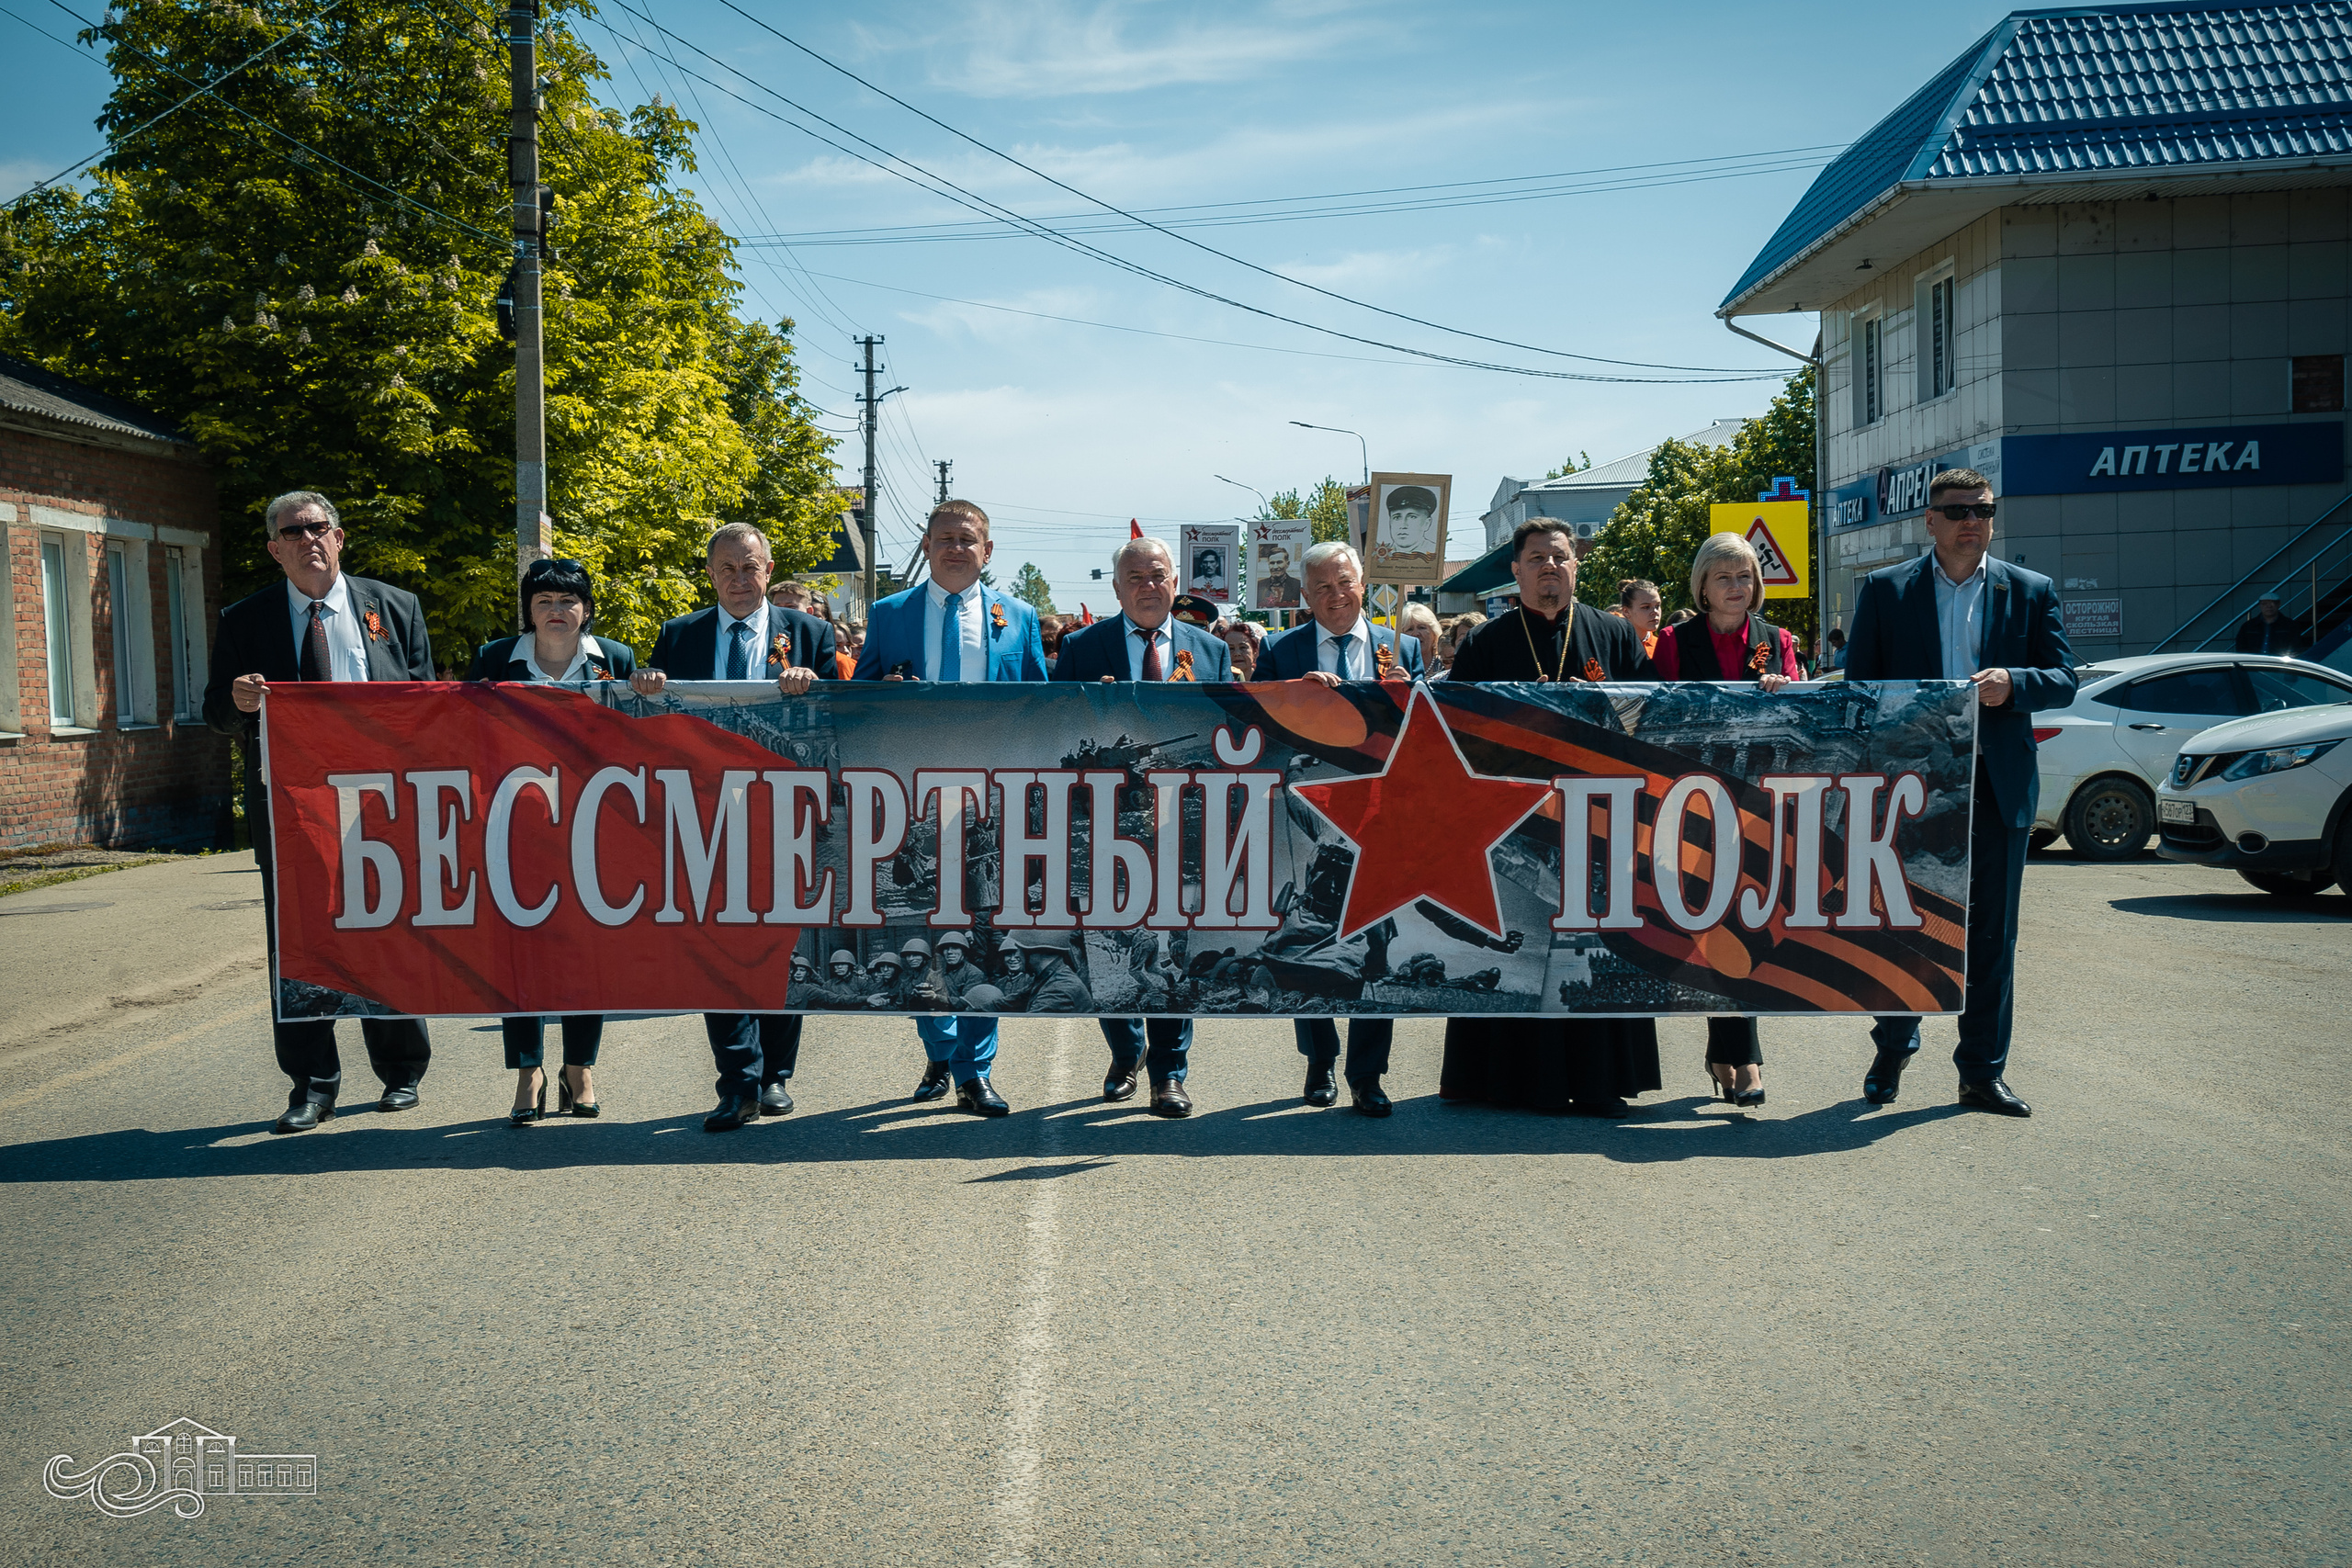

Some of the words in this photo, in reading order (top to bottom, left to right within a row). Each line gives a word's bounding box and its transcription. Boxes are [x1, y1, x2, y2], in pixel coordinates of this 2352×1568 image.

[2089, 440, 2260, 477] АПТЕКА
[1886, 463, 1937, 514] АПРЕЛ
[1832, 497, 1863, 527] АПТЕКА
[2065, 601, 2119, 615] ОСТОРОЖНО!
[325, 724, 1283, 930] БЕССМЕРТНЫЙ
[1551, 773, 1928, 931] ПОЛК
